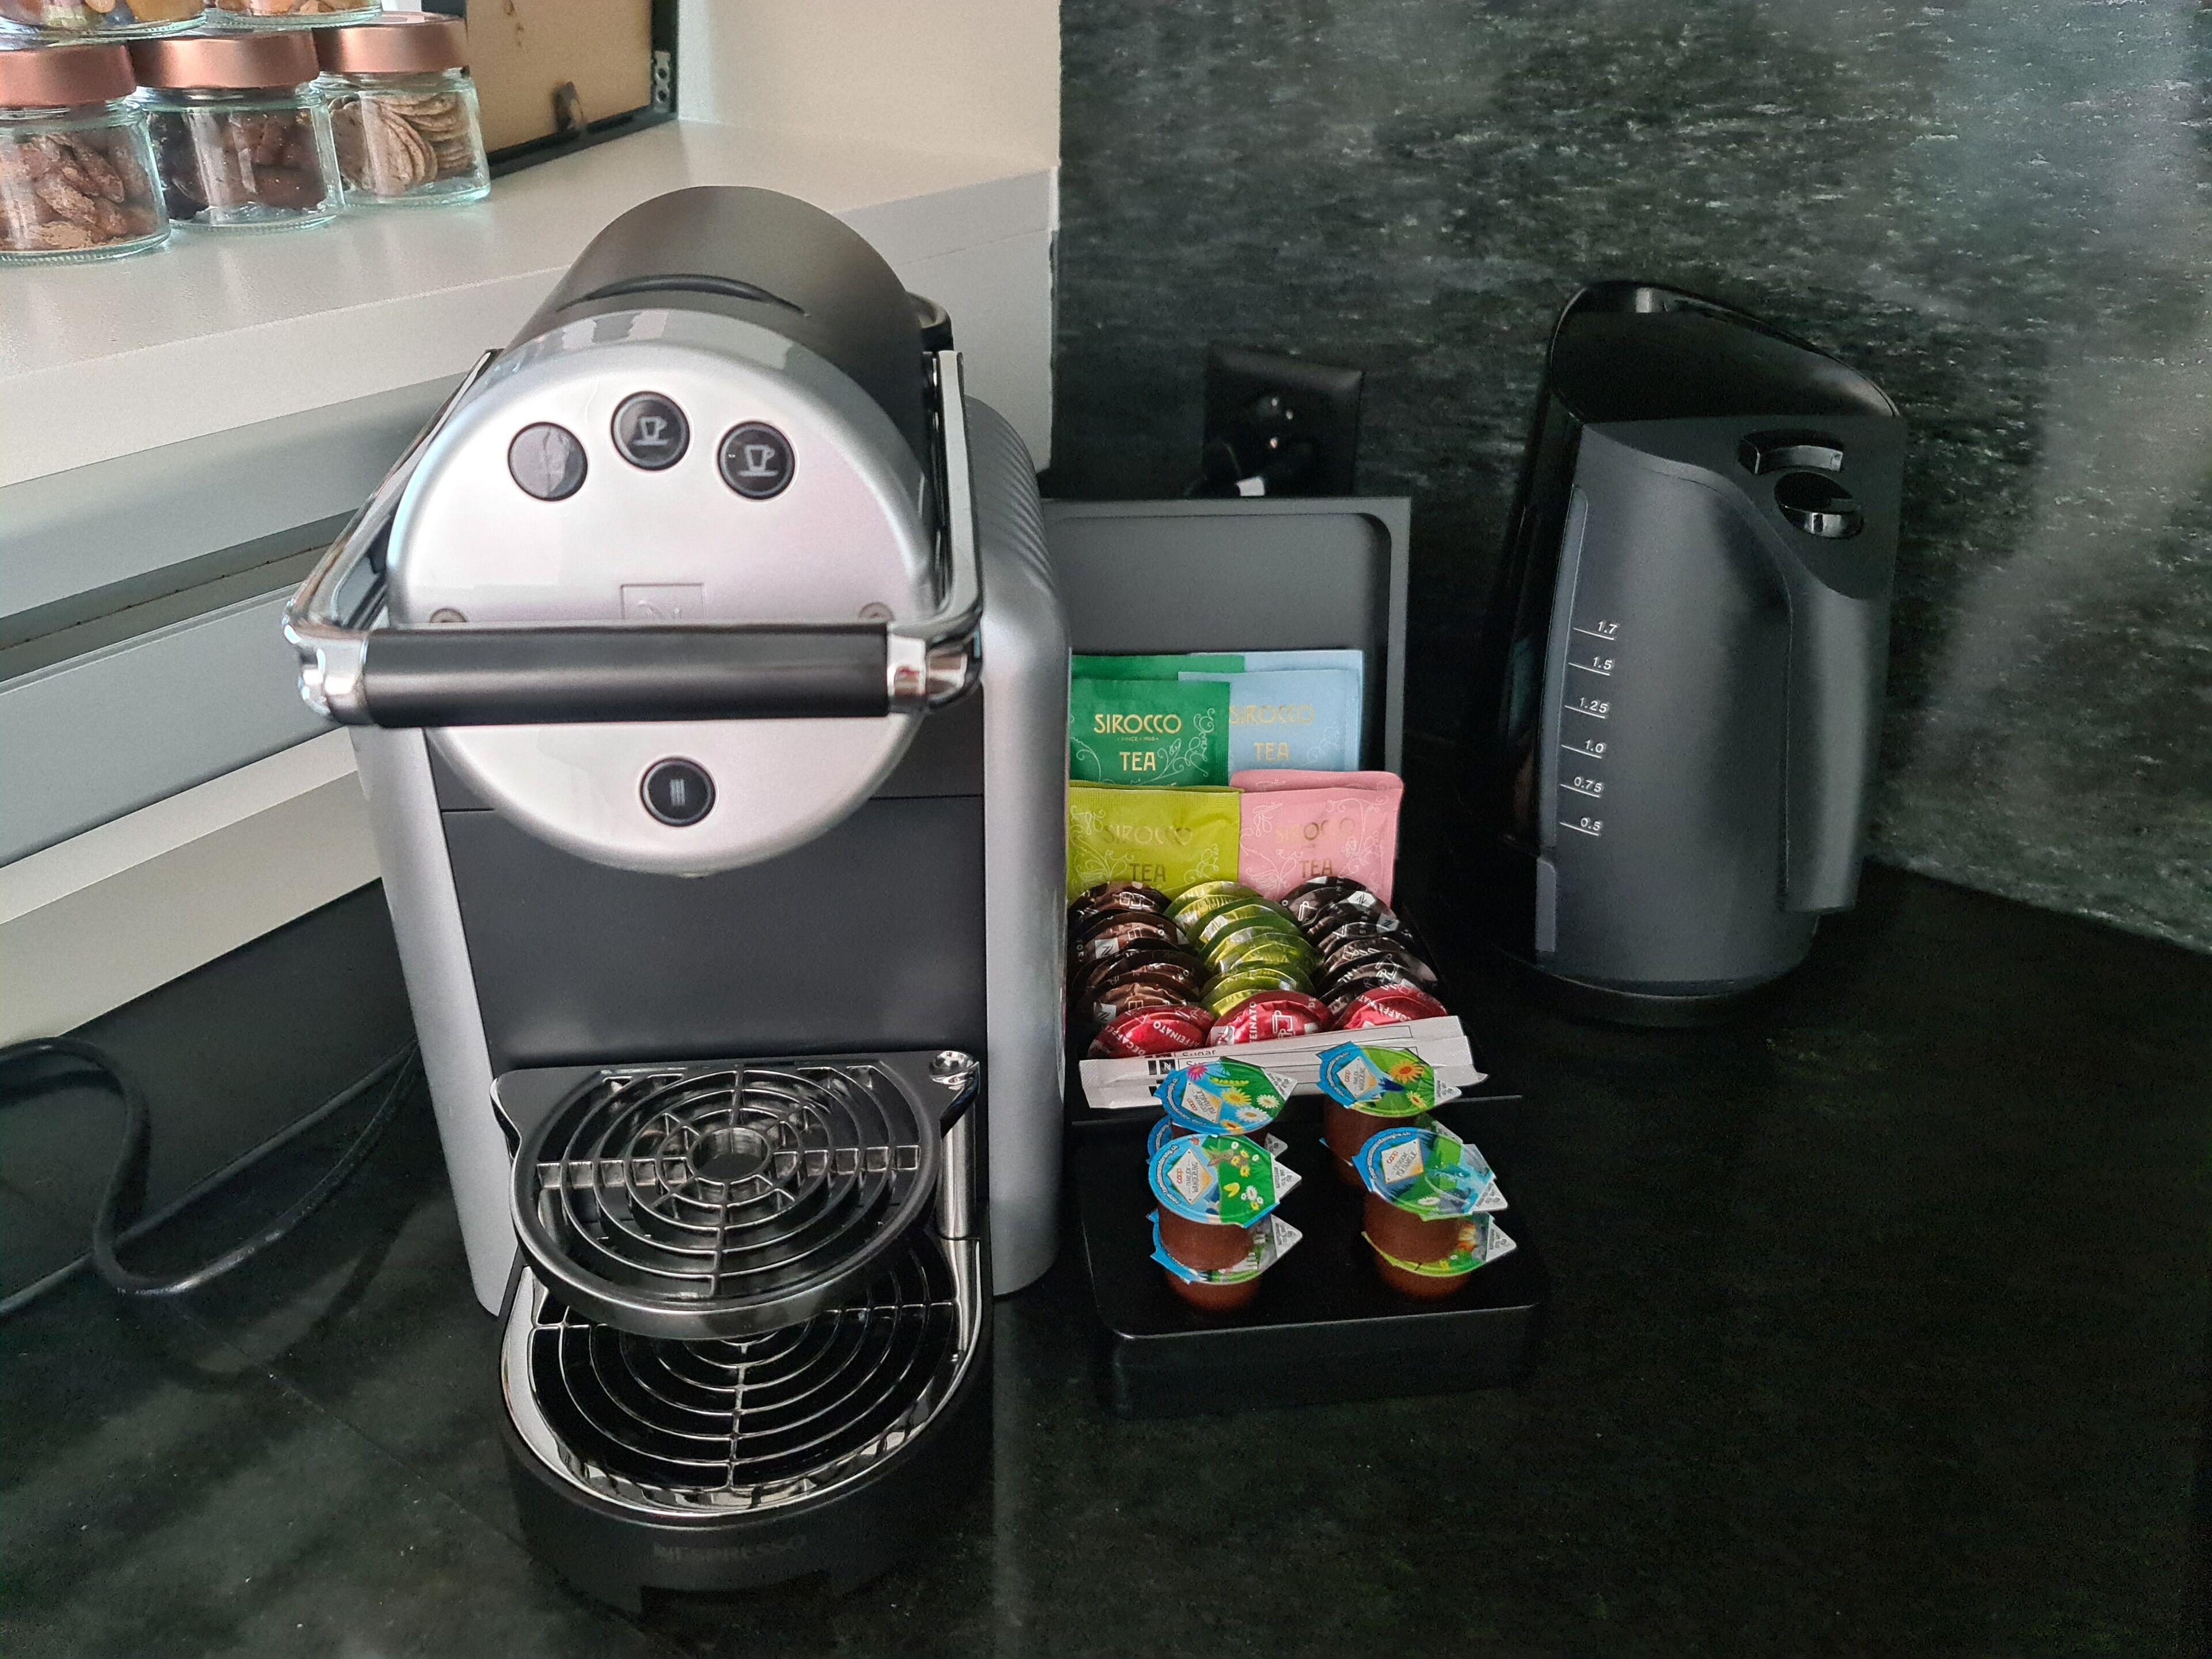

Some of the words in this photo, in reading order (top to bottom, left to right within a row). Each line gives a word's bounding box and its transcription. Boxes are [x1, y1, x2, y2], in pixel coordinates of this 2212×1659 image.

[1598, 621, 1618, 634] 1.7
[1593, 656, 1613, 670] 1.5
[1580, 697, 1608, 713] 1.25
[1229, 704, 1315, 725] SIROCCO
[1093, 714, 1181, 734] SIROCCO
[1253, 742, 1290, 762] TEA
[1585, 740, 1604, 753] 1.0
[1119, 751, 1156, 771] TEA
[1574, 777, 1603, 793] 0.75
[1580, 817, 1601, 831] 0.5
[1128, 863, 1166, 882] TEA
[1300, 857, 1332, 878] TEA
